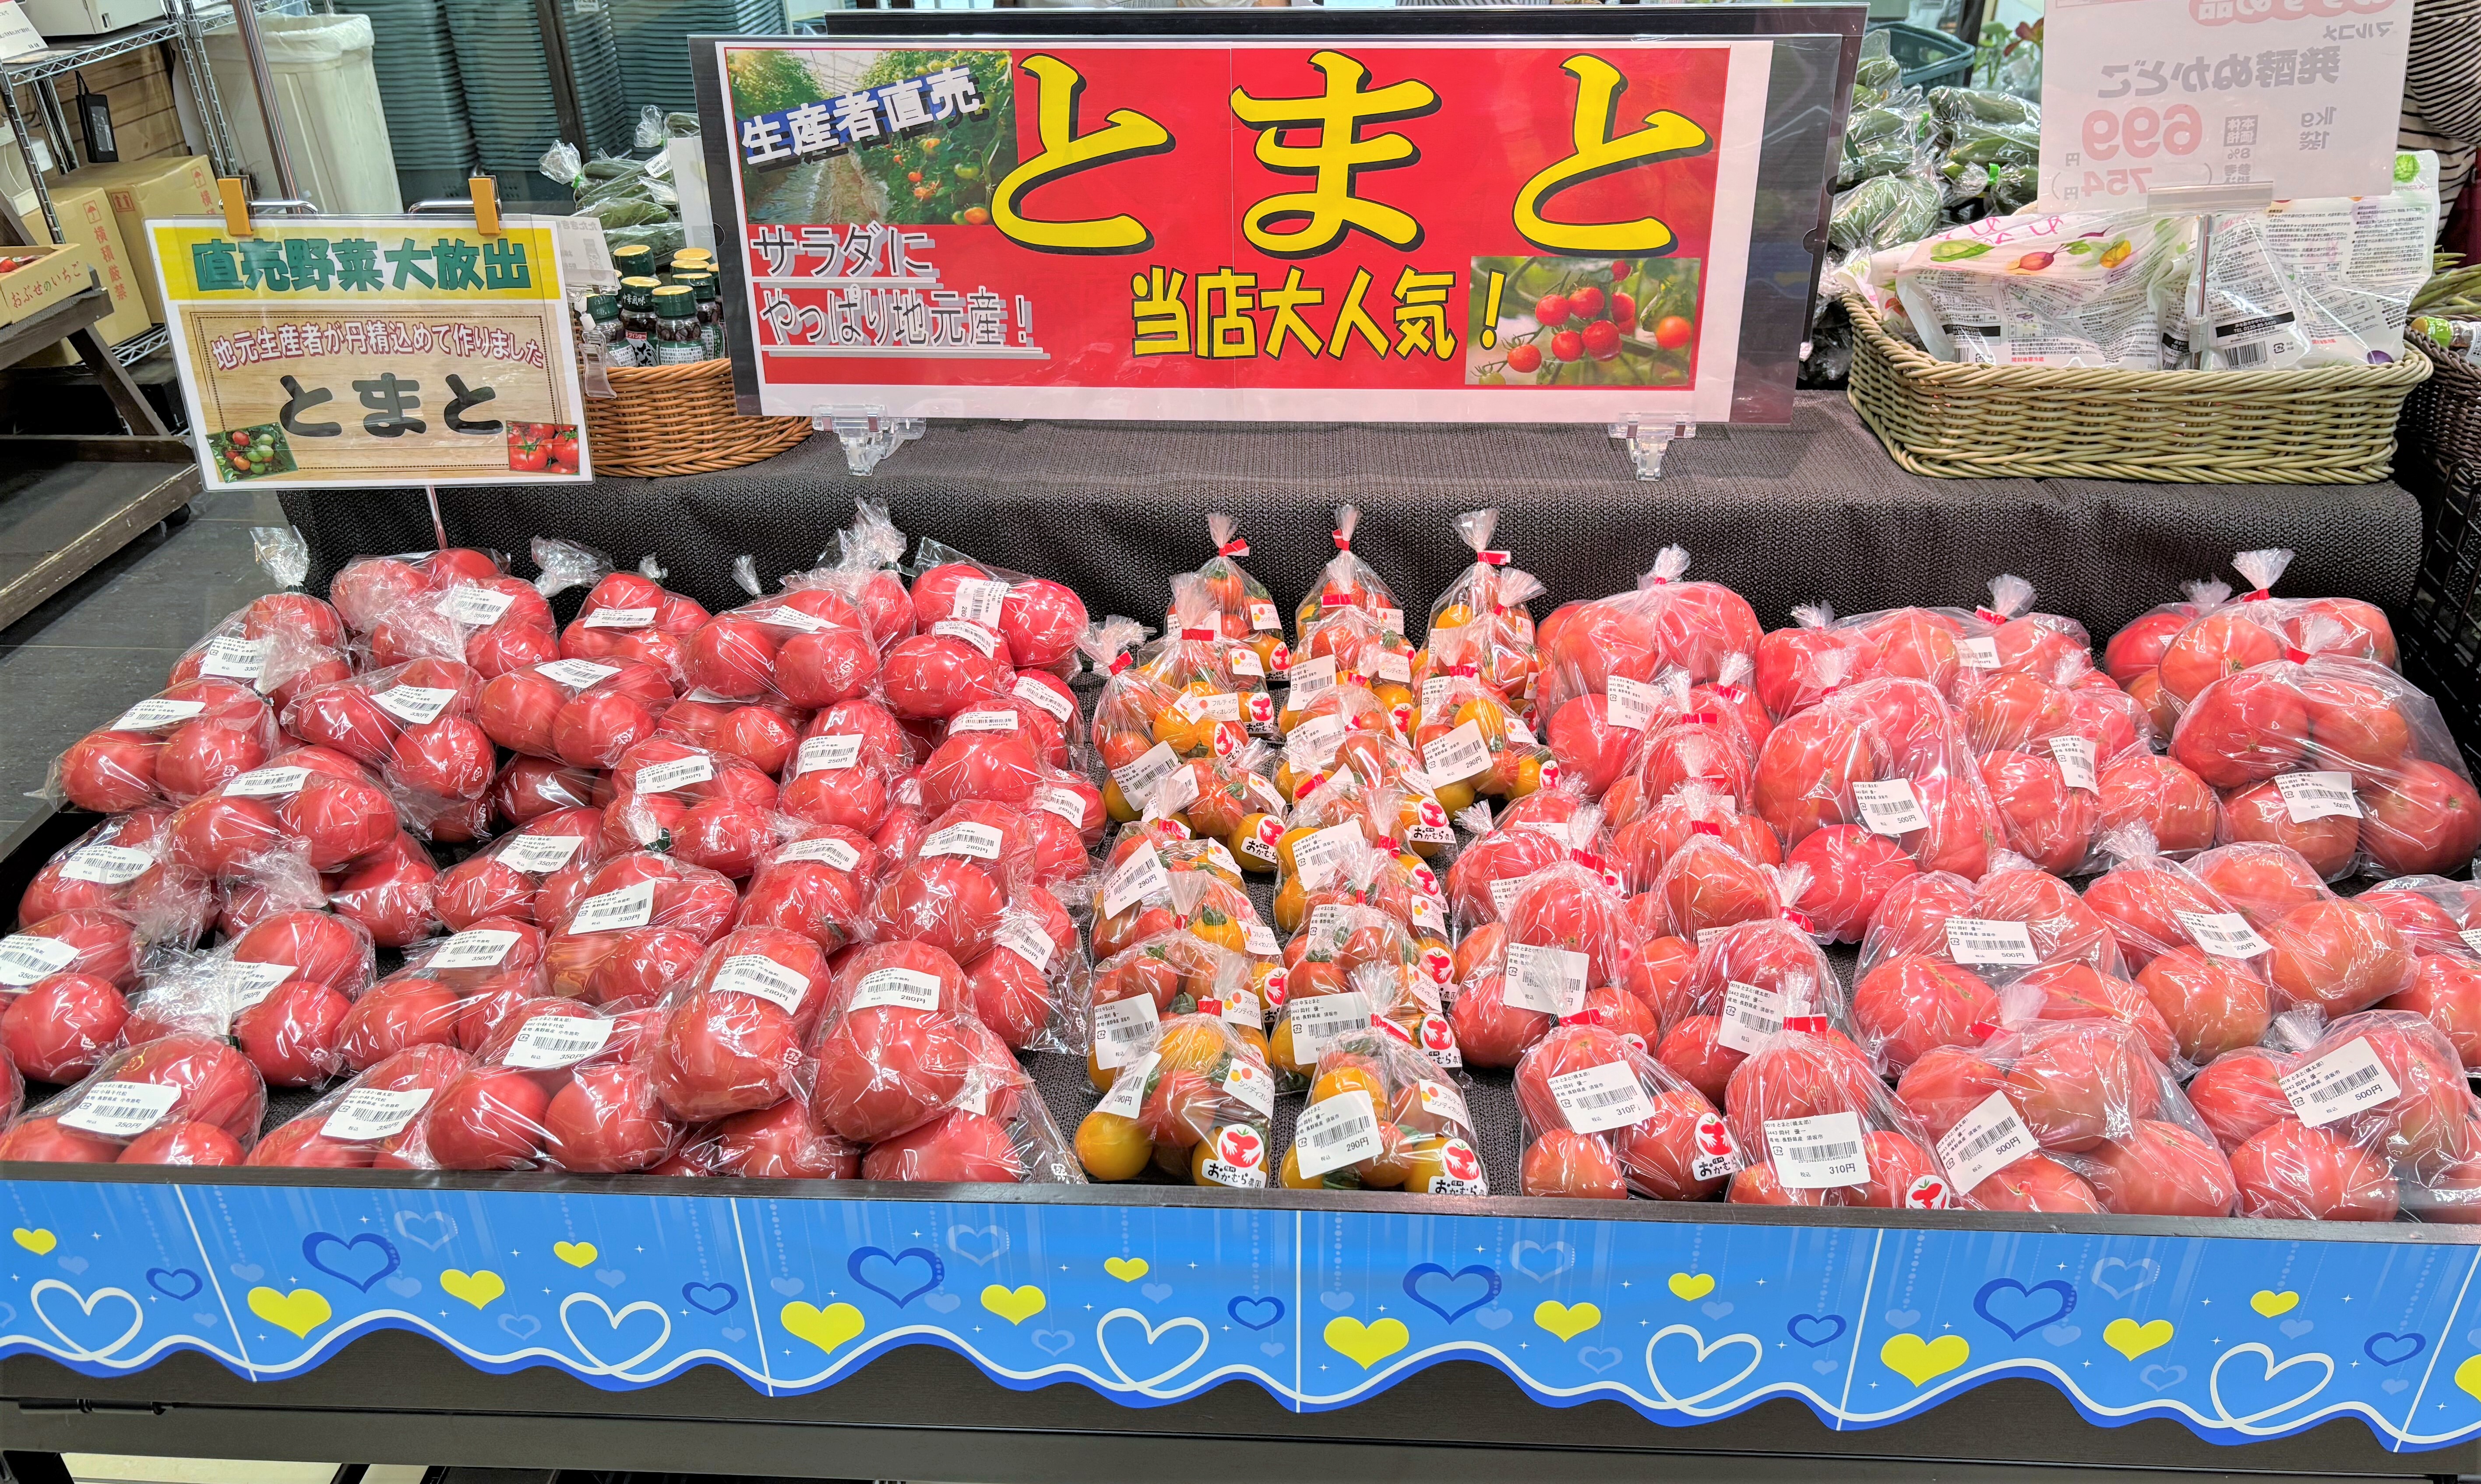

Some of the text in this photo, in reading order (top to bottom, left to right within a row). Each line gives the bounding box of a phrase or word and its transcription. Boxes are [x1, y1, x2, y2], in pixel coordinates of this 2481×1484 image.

[742, 66, 989, 169] 生産者直売
[990, 49, 1713, 258] とまと
[94, 226, 127, 301] 横積厳禁
[192, 238, 532, 292] 直売野菜大放出
[751, 219, 933, 278] サラダに
[12, 261, 81, 308] おぶせのいちご
[761, 284, 1030, 347] やっぱり地元産!
[1131, 265, 1507, 362] 当店大人気!
[211, 319, 544, 372] 地元生産者が丹精込めて作りました
[279, 372, 504, 438] とまと
[1466, 756, 1483, 769] 290円
[1897, 815, 1916, 824] 500円
[1138, 874, 1157, 889] 290円
[618, 914, 640, 922] 330円
[2354, 1083, 2383, 1101] 500円
[1616, 1104, 1641, 1115] 310円
[1777, 1119, 1811, 1128] とまと(桃太郎)
[1346, 1137, 1370, 1153] 290円
[1995, 1136, 2021, 1155] 500円
[1829, 1163, 1856, 1175] 310円
